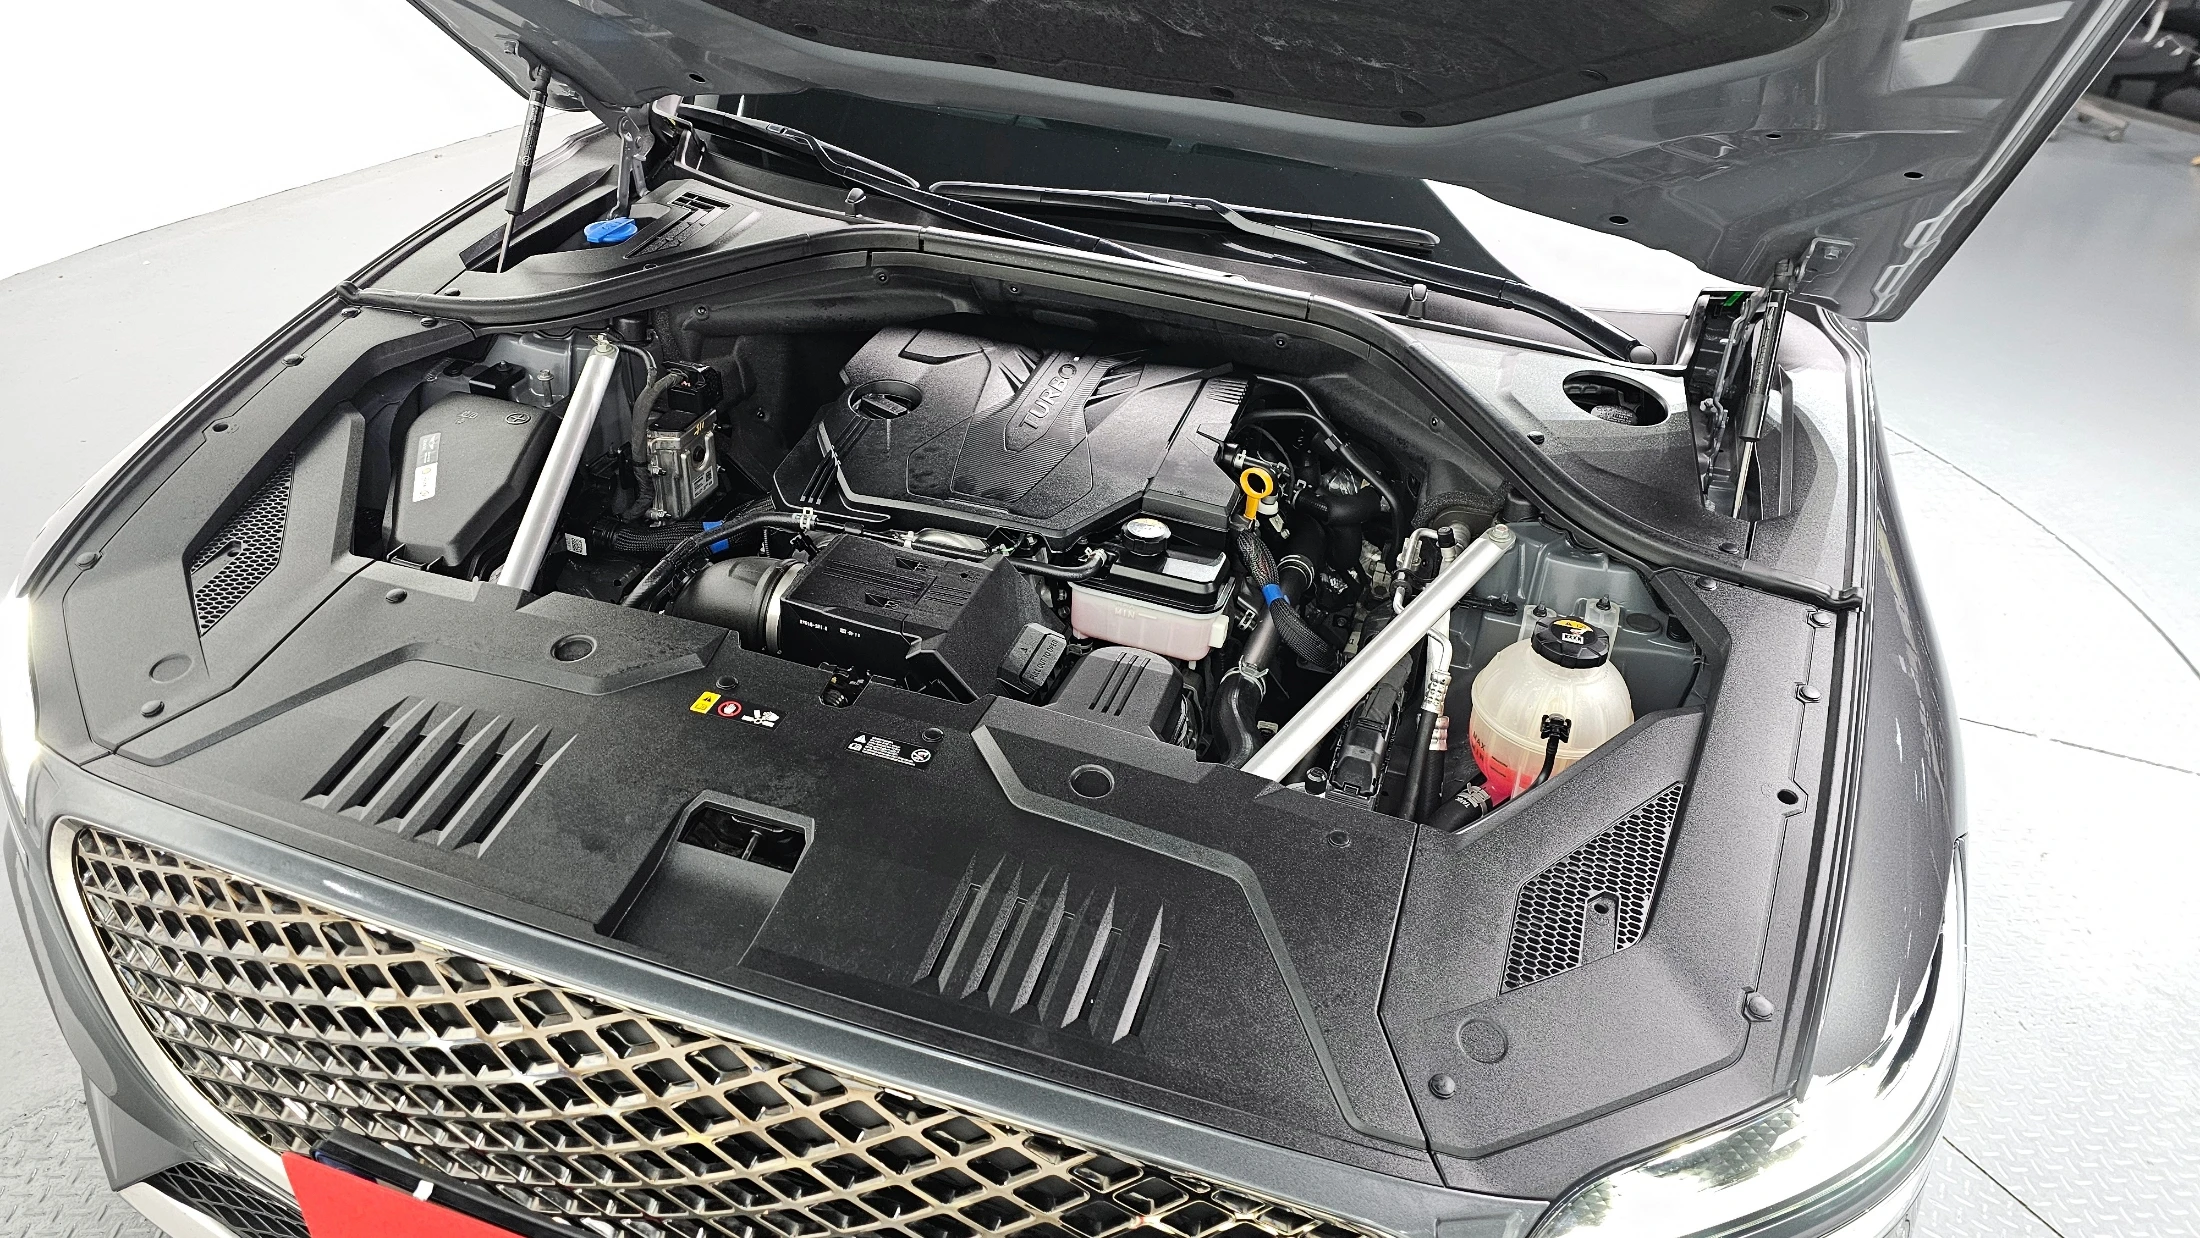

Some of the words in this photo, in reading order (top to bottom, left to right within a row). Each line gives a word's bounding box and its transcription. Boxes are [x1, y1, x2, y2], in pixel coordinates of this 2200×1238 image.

[1018, 363, 1078, 430] TURBO
[1114, 607, 1135, 619] MIN
[1472, 730, 1486, 751] MAX
